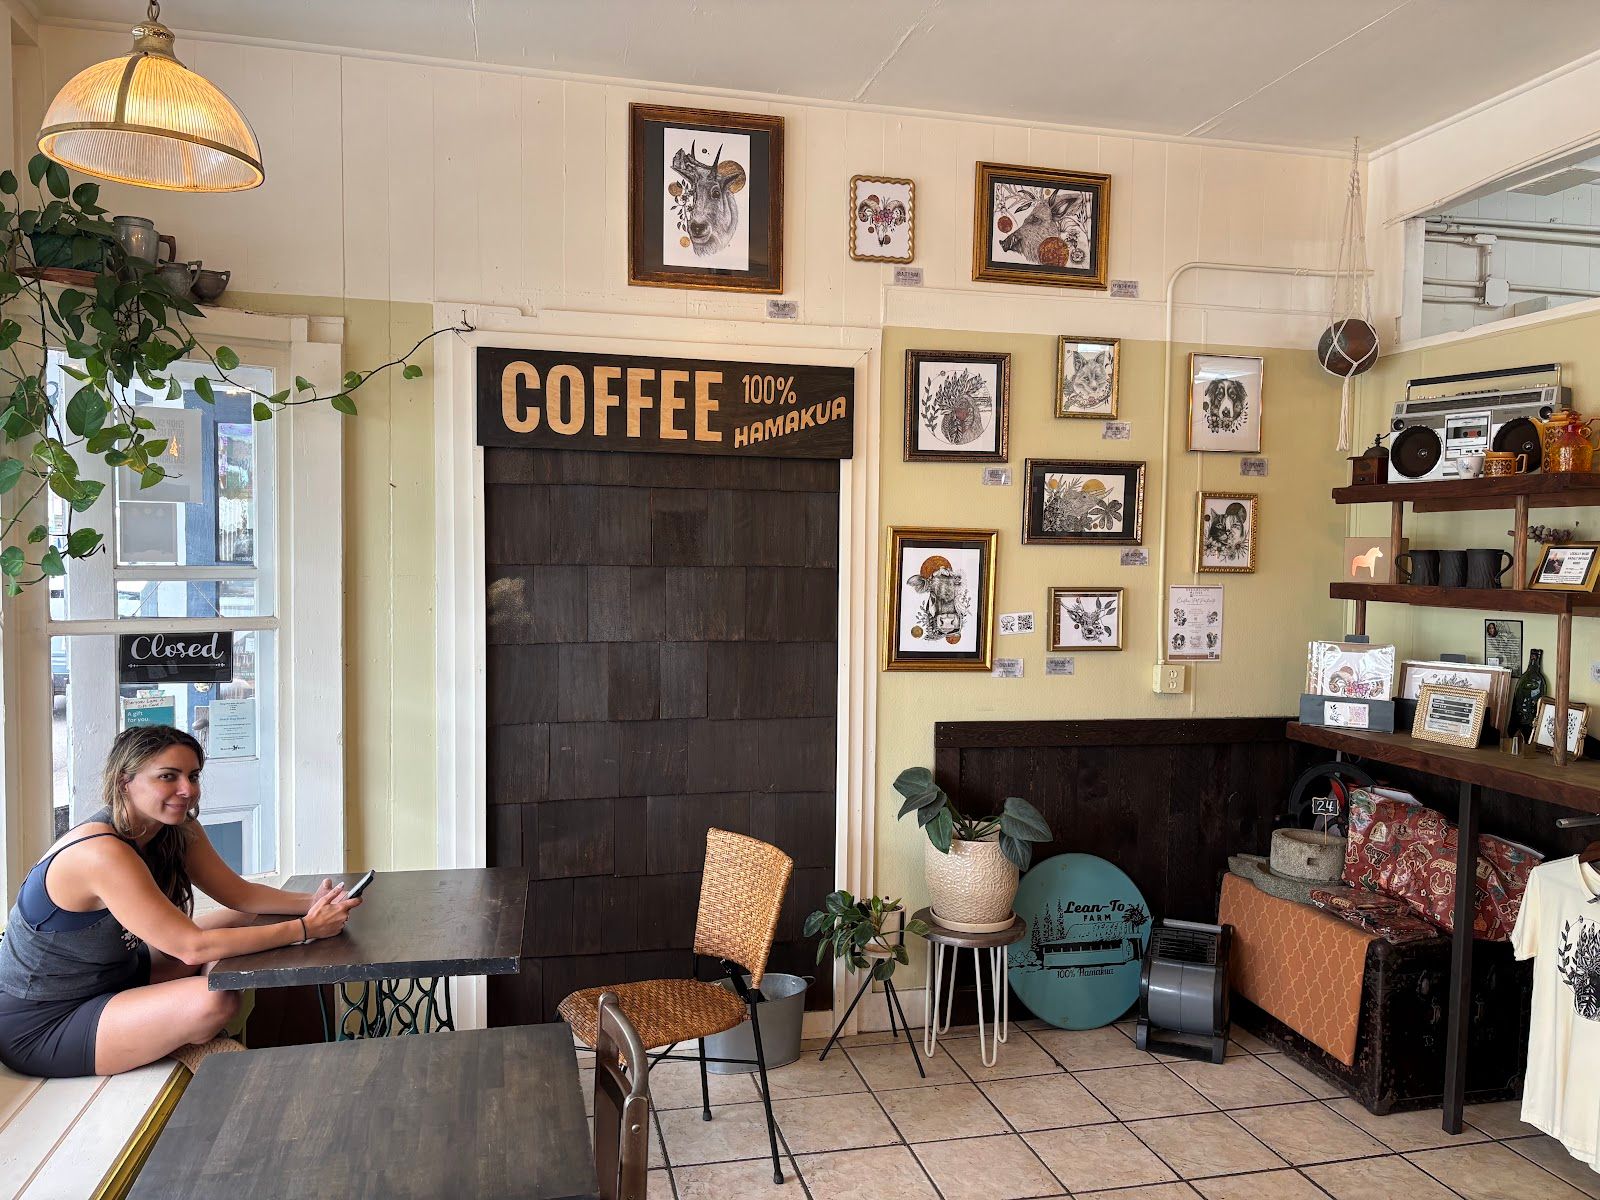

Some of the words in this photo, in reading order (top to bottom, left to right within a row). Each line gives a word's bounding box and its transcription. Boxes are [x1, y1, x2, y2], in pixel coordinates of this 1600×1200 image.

[741, 374, 797, 406] 100%
[501, 360, 724, 442] COFFEE
[734, 396, 847, 449] HAMAKUA
[130, 632, 225, 660] Closed
[1316, 800, 1335, 813] 24
[1063, 899, 1125, 914] Lean-To
[1083, 914, 1112, 922] FARM
[1056, 968, 1076, 979] 100%
[1078, 967, 1115, 978] Hamakua
